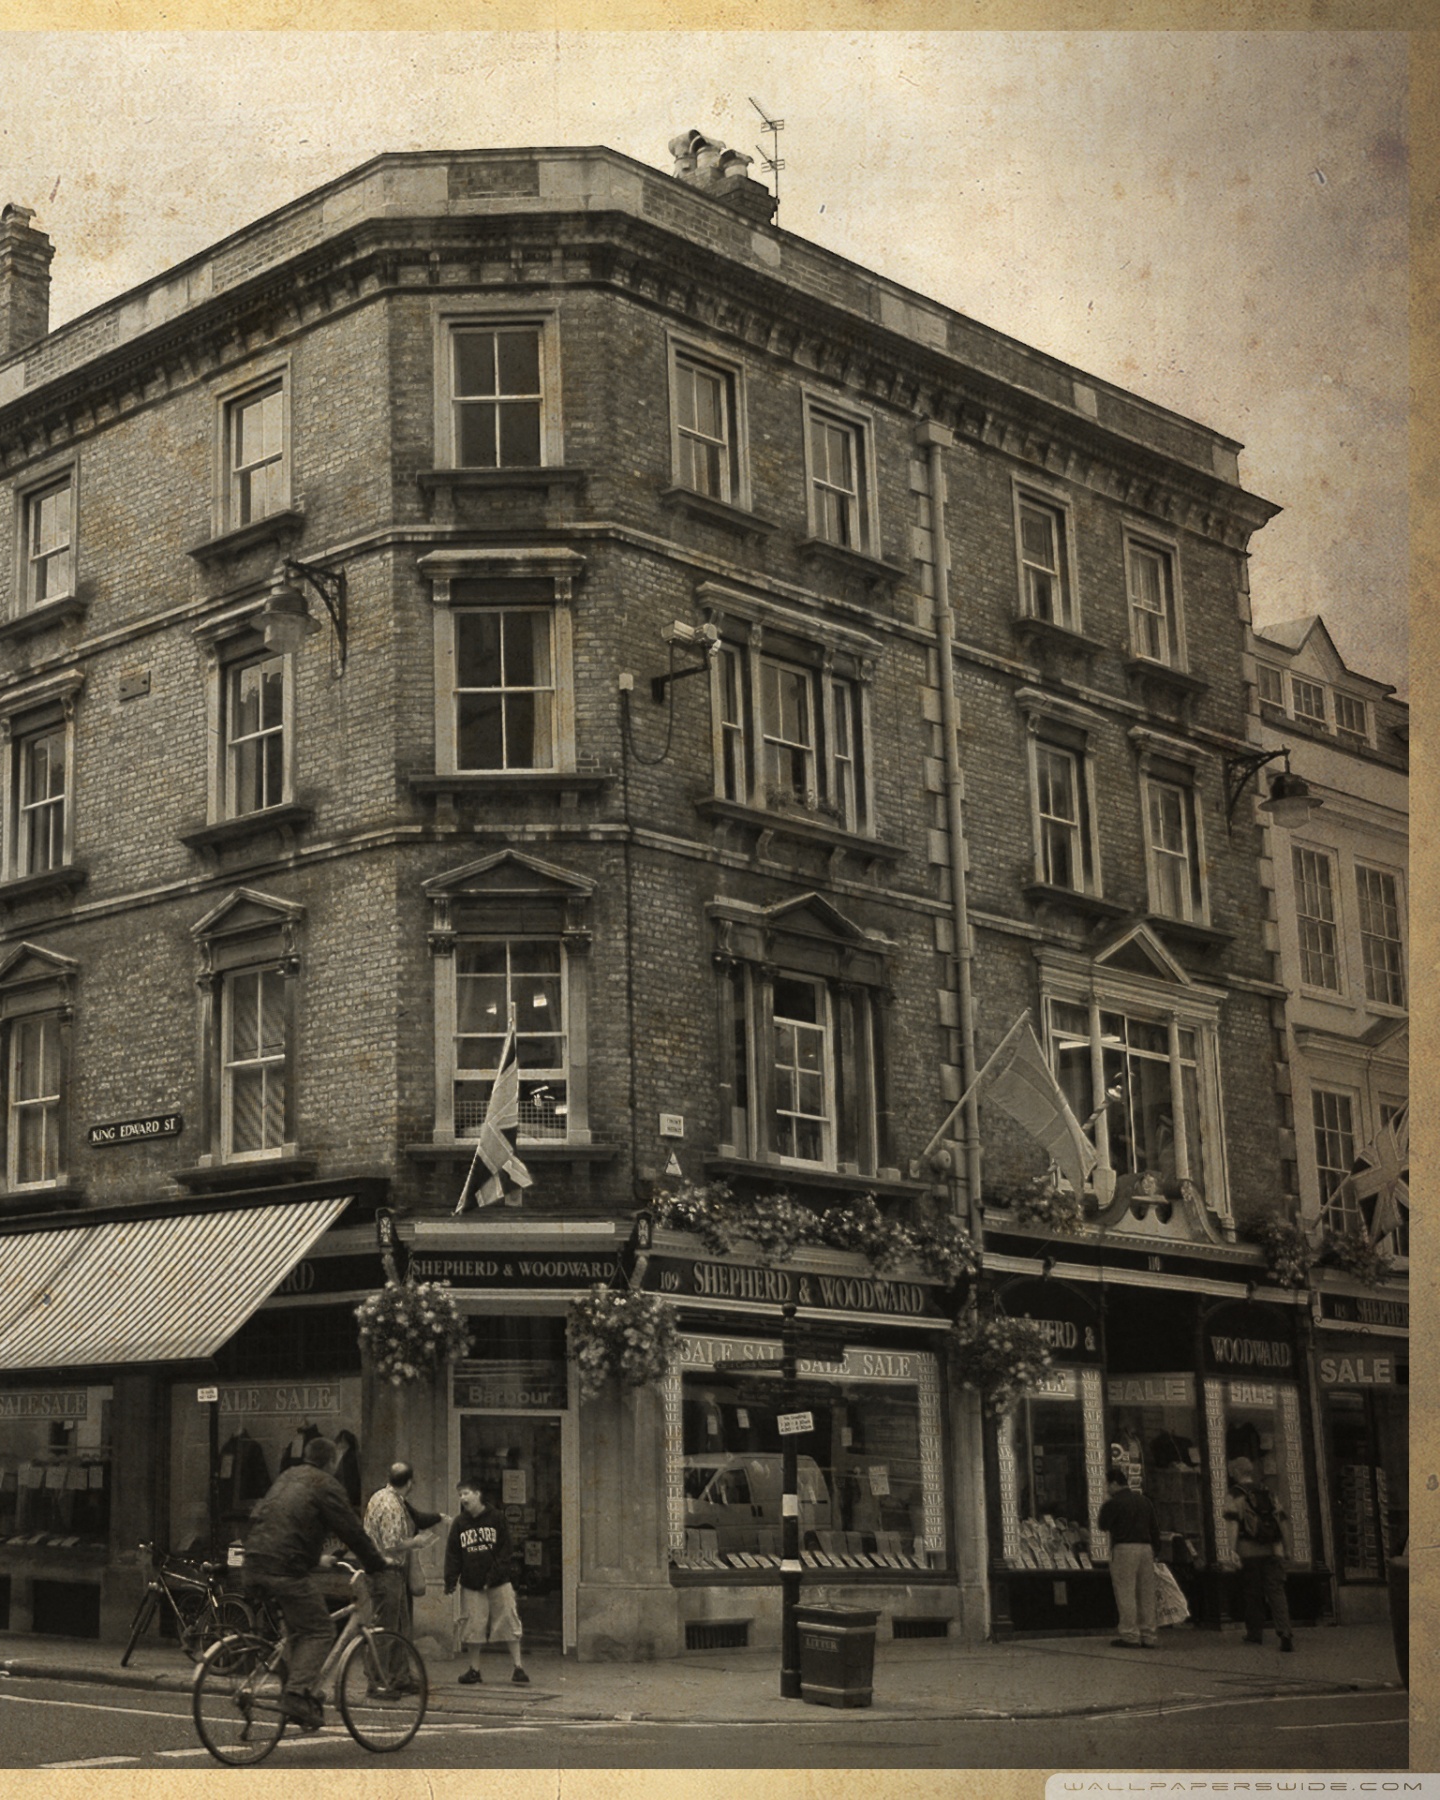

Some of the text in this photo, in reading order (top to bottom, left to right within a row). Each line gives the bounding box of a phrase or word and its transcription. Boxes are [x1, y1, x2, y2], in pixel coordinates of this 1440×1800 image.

[92, 1118, 176, 1142] KING EDWARD ST
[412, 1260, 616, 1278] SHEPHERD & WOODWARD
[660, 1261, 924, 1314] 109 SHEPHERD & WOODWARD
[1084, 1325, 1096, 1352] &
[680, 1337, 733, 1363] SALE
[862, 1354, 912, 1378] SALE
[1210, 1335, 1293, 1368] WOODWARD
[1320, 1358, 1391, 1384] SALE
[220, 1387, 332, 1413] ALE SALE
[469, 1385, 552, 1404] Barbour
[1107, 1380, 1187, 1401] SALE
[1231, 1381, 1274, 1404] SALE
[40, 1394, 88, 1416] SALE
[805, 1637, 838, 1650] LITTER
